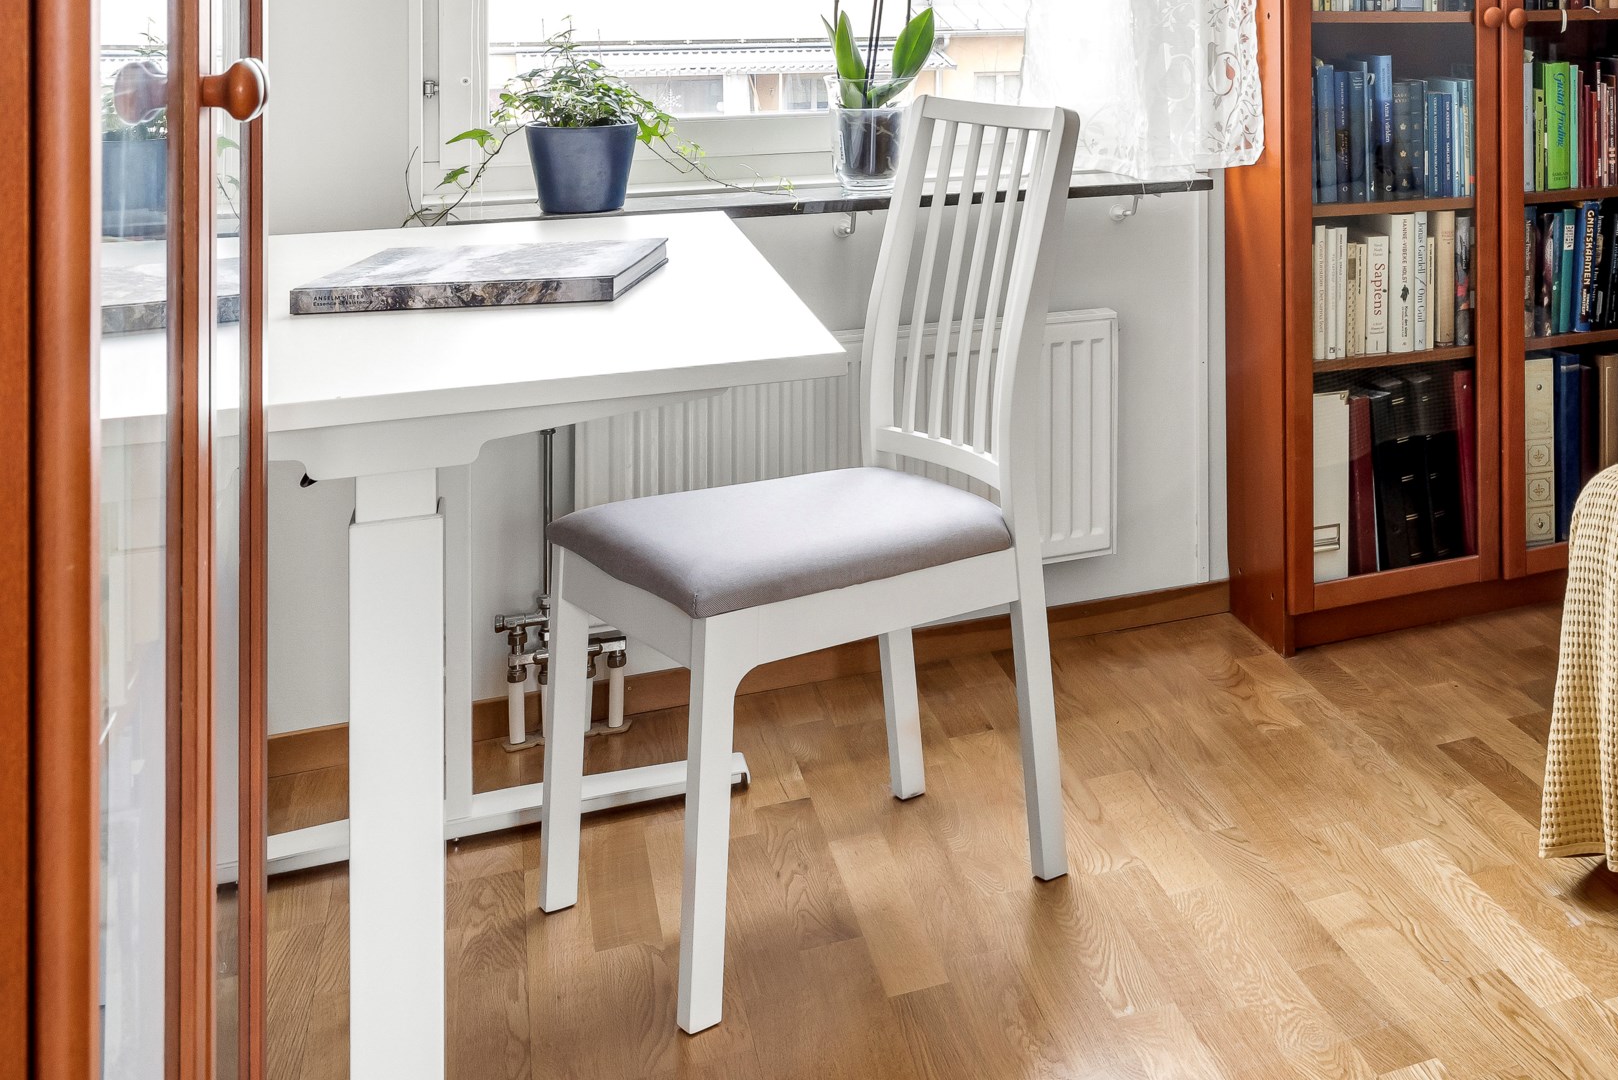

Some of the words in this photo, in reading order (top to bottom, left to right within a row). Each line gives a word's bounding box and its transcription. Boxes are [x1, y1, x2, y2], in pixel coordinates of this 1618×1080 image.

[1554, 73, 1566, 106] Gustaf
[1555, 107, 1566, 147] Fröding
[1417, 221, 1426, 243] Jonas
[1583, 210, 1595, 285] GNISTSKÄRMEN
[1418, 245, 1426, 274] Gardell
[1371, 263, 1385, 316] Sapiens
[1418, 288, 1425, 303] Om
[1418, 305, 1426, 323] Gud
